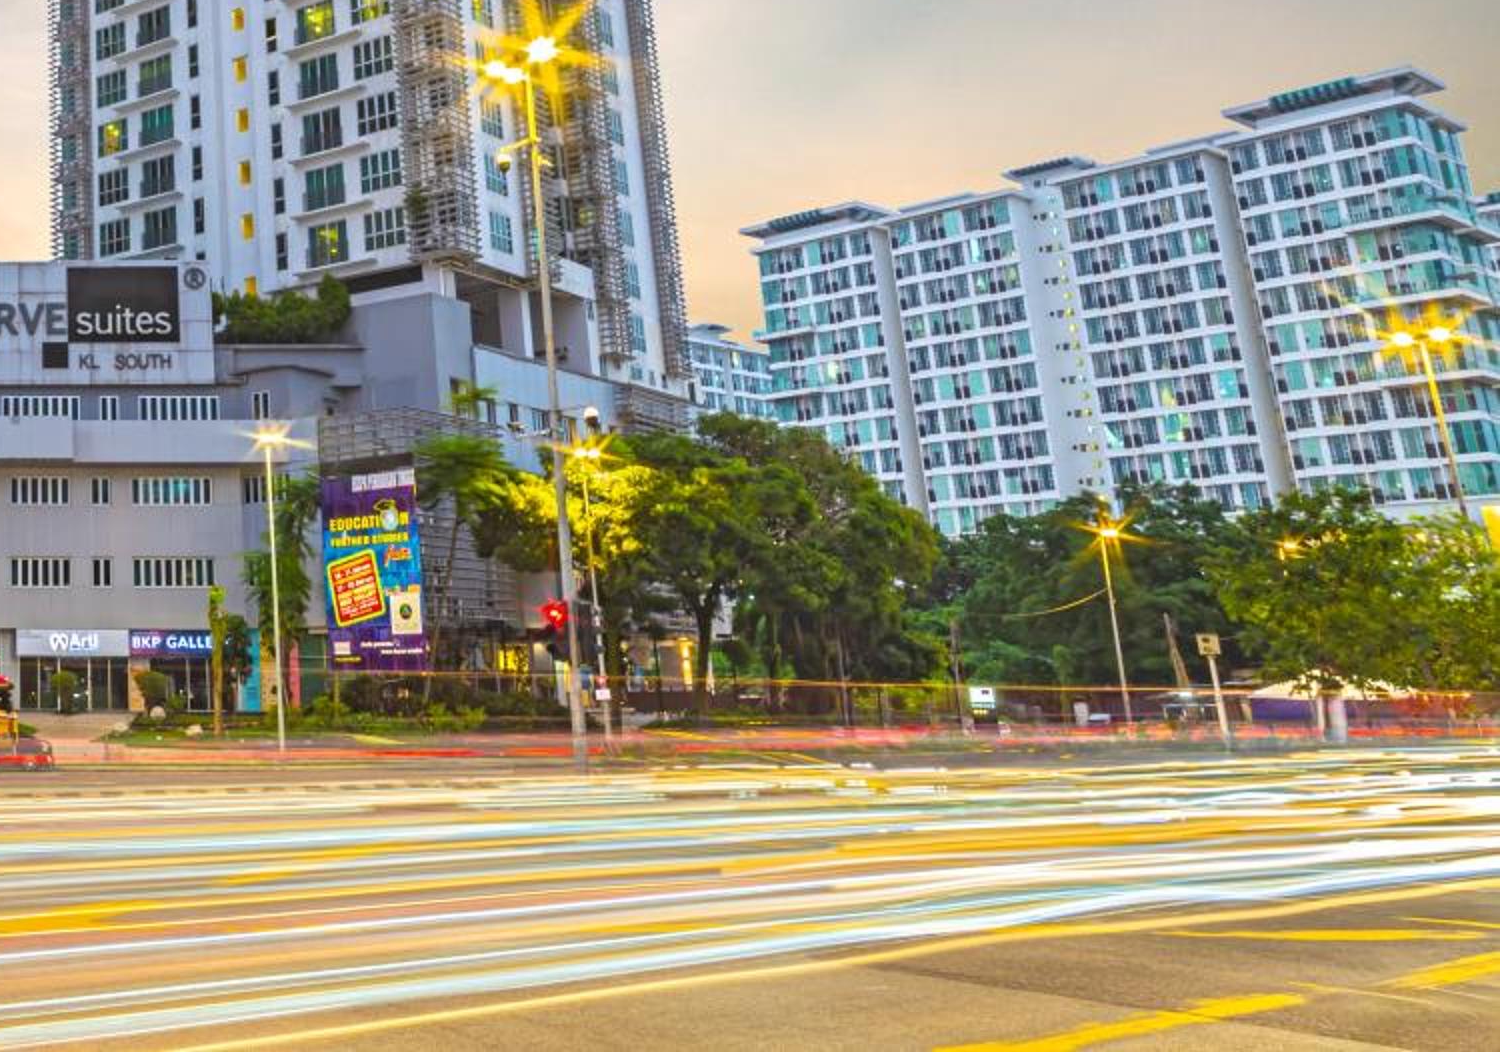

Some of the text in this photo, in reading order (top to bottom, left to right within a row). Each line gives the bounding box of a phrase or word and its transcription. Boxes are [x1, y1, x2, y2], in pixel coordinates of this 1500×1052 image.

[76, 304, 172, 335] suites
[79, 353, 172, 370] KL SOUTH
[131, 634, 230, 650] BKP GALLE
